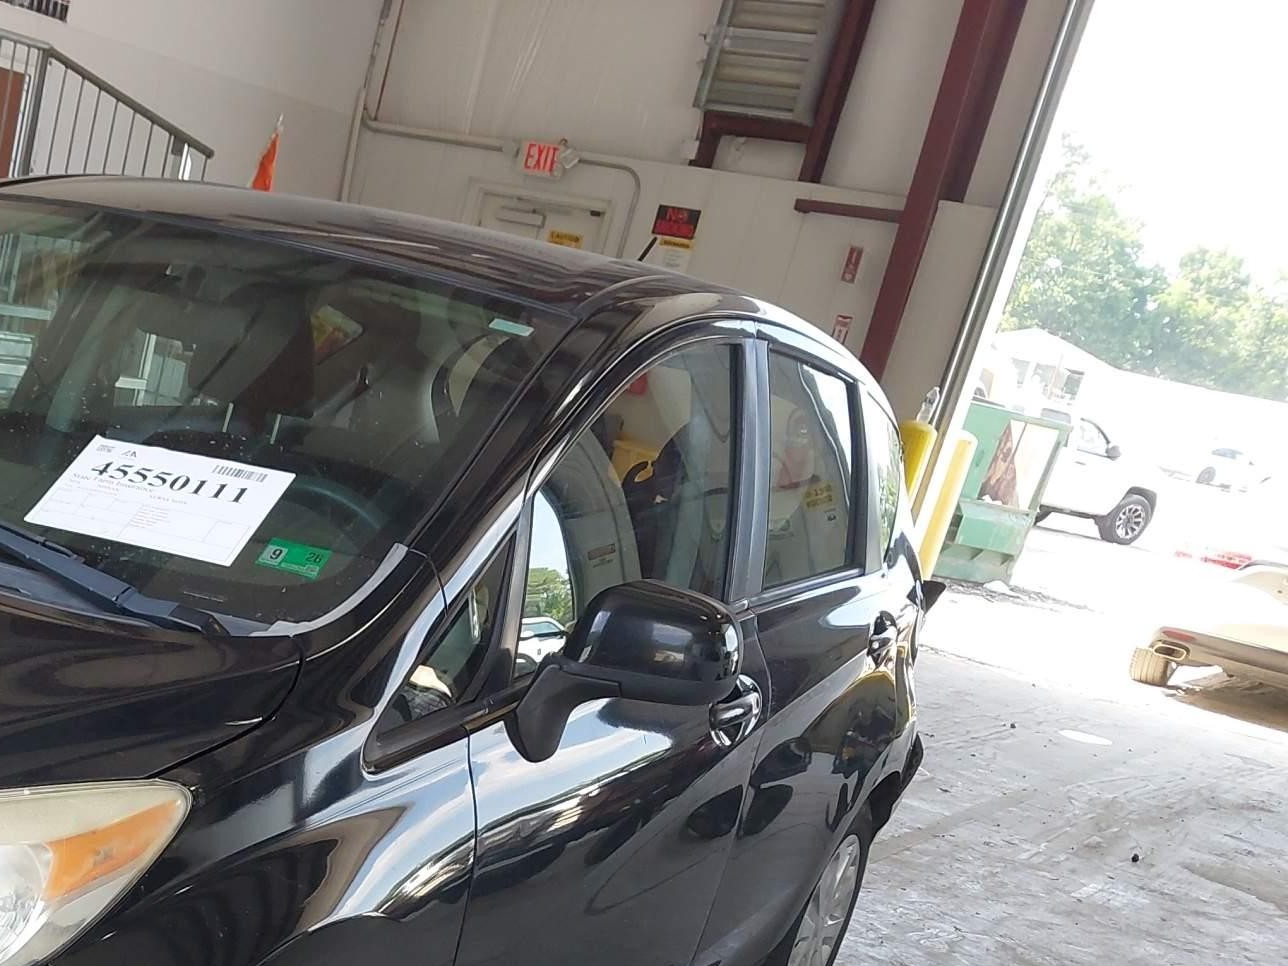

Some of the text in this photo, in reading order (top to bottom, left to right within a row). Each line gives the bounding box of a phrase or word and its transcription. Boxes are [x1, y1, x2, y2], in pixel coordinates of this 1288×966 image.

[524, 143, 560, 172] EXIT
[91, 460, 248, 504] 45550111
[270, 548, 283, 560] 9
